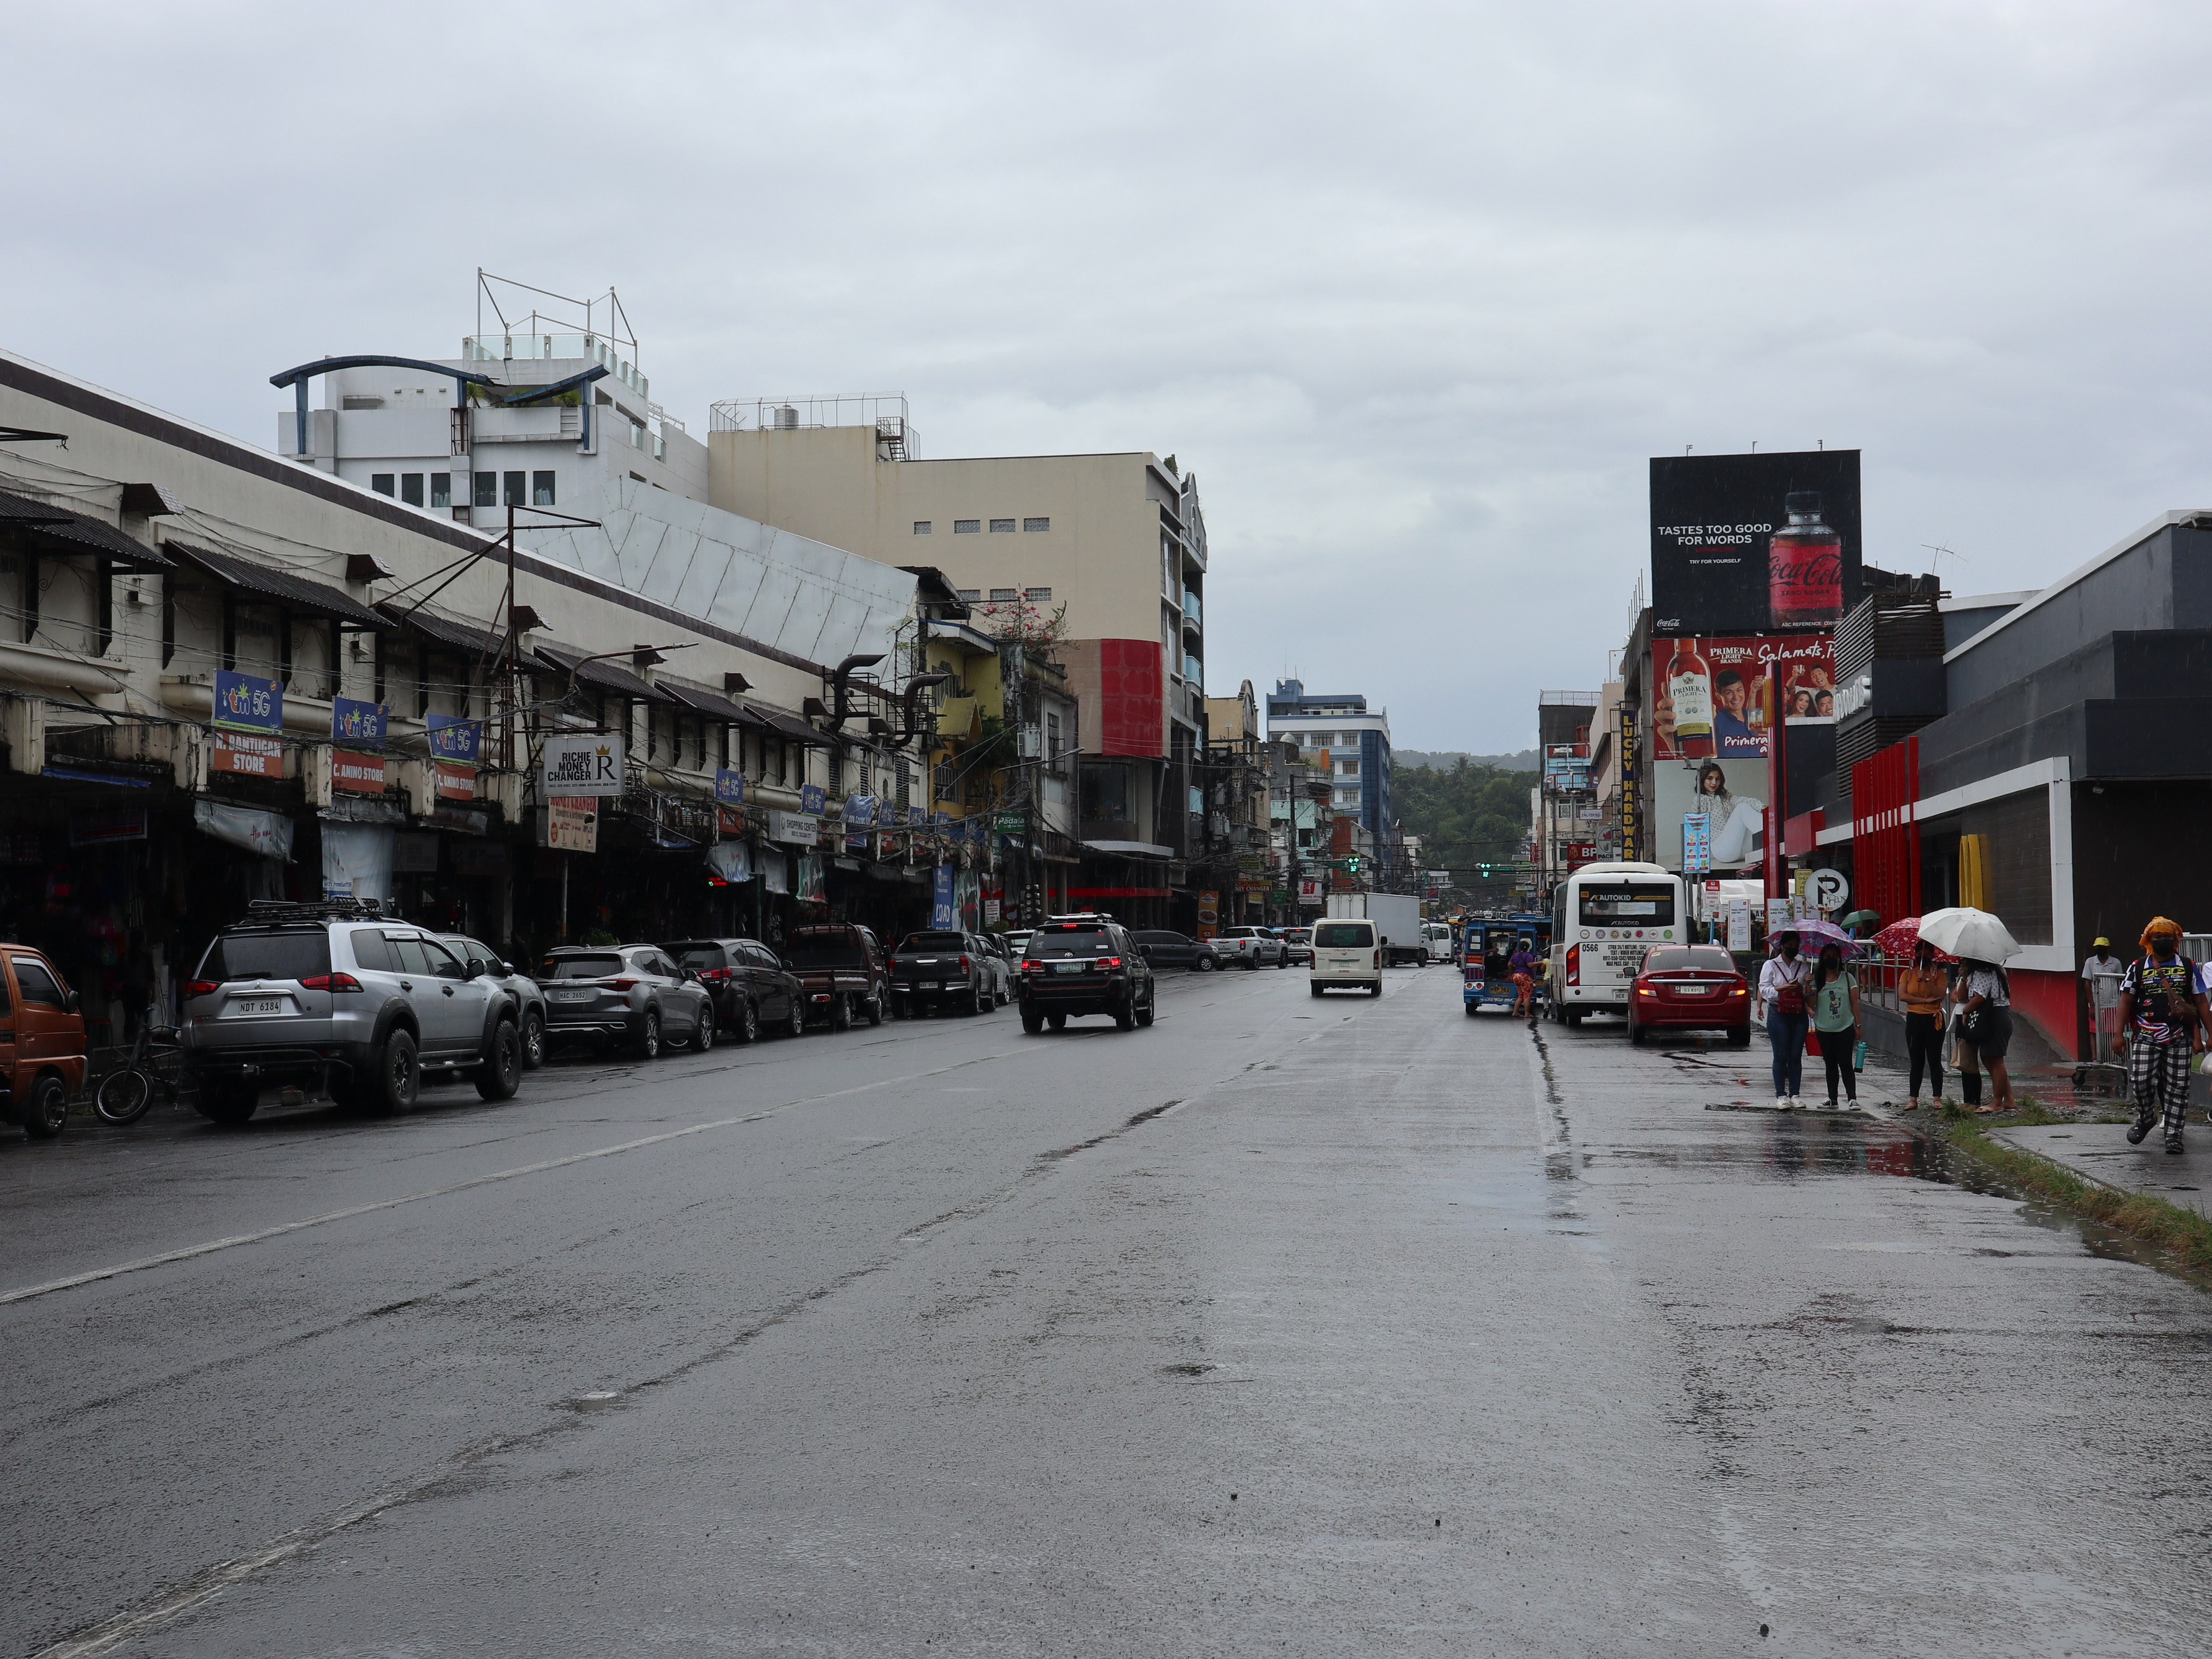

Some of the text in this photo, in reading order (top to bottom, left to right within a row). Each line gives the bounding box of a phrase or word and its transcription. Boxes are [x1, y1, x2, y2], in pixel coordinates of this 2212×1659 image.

[1658, 524, 1772, 535] TASTES TOO GOOD
[1678, 535, 1752, 545] FOR WORDS
[1657, 619, 1681, 627] Coca-Cola
[1709, 647, 1753, 656] PRIMERA
[1757, 640, 1825, 664] Salamats,
[1673, 686, 1707, 696] PRIMERA
[252, 690, 270, 717] 5G
[362, 714, 377, 737] 5G
[216, 733, 281, 757] R. BANTUGAN
[458, 729, 470, 751] 5G
[1724, 735, 1767, 747] Primera
[233, 753, 265, 773] STORE
[562, 752, 591, 762] RICHIE
[333, 763, 384, 782] C. ANINO STORE
[558, 762, 591, 772] MONEY
[595, 755, 617, 780] R
[444, 775, 460, 789] ANINO
[460, 778, 474, 791] STORE
[548, 771, 591, 782] CHANGER
[730, 779, 739, 796] 5G
[1623, 716, 1635, 862] LUCKY HARDWAR
[551, 796, 596, 813] MONEY CHANGER
[787, 819, 816, 832] SHOPPING CENTER
[1582, 848, 1597, 857] BP
[936, 904, 950, 922] LOAD
[1582, 943, 1599, 952] 0566
[240, 1002, 279, 1012] NDT 6184
